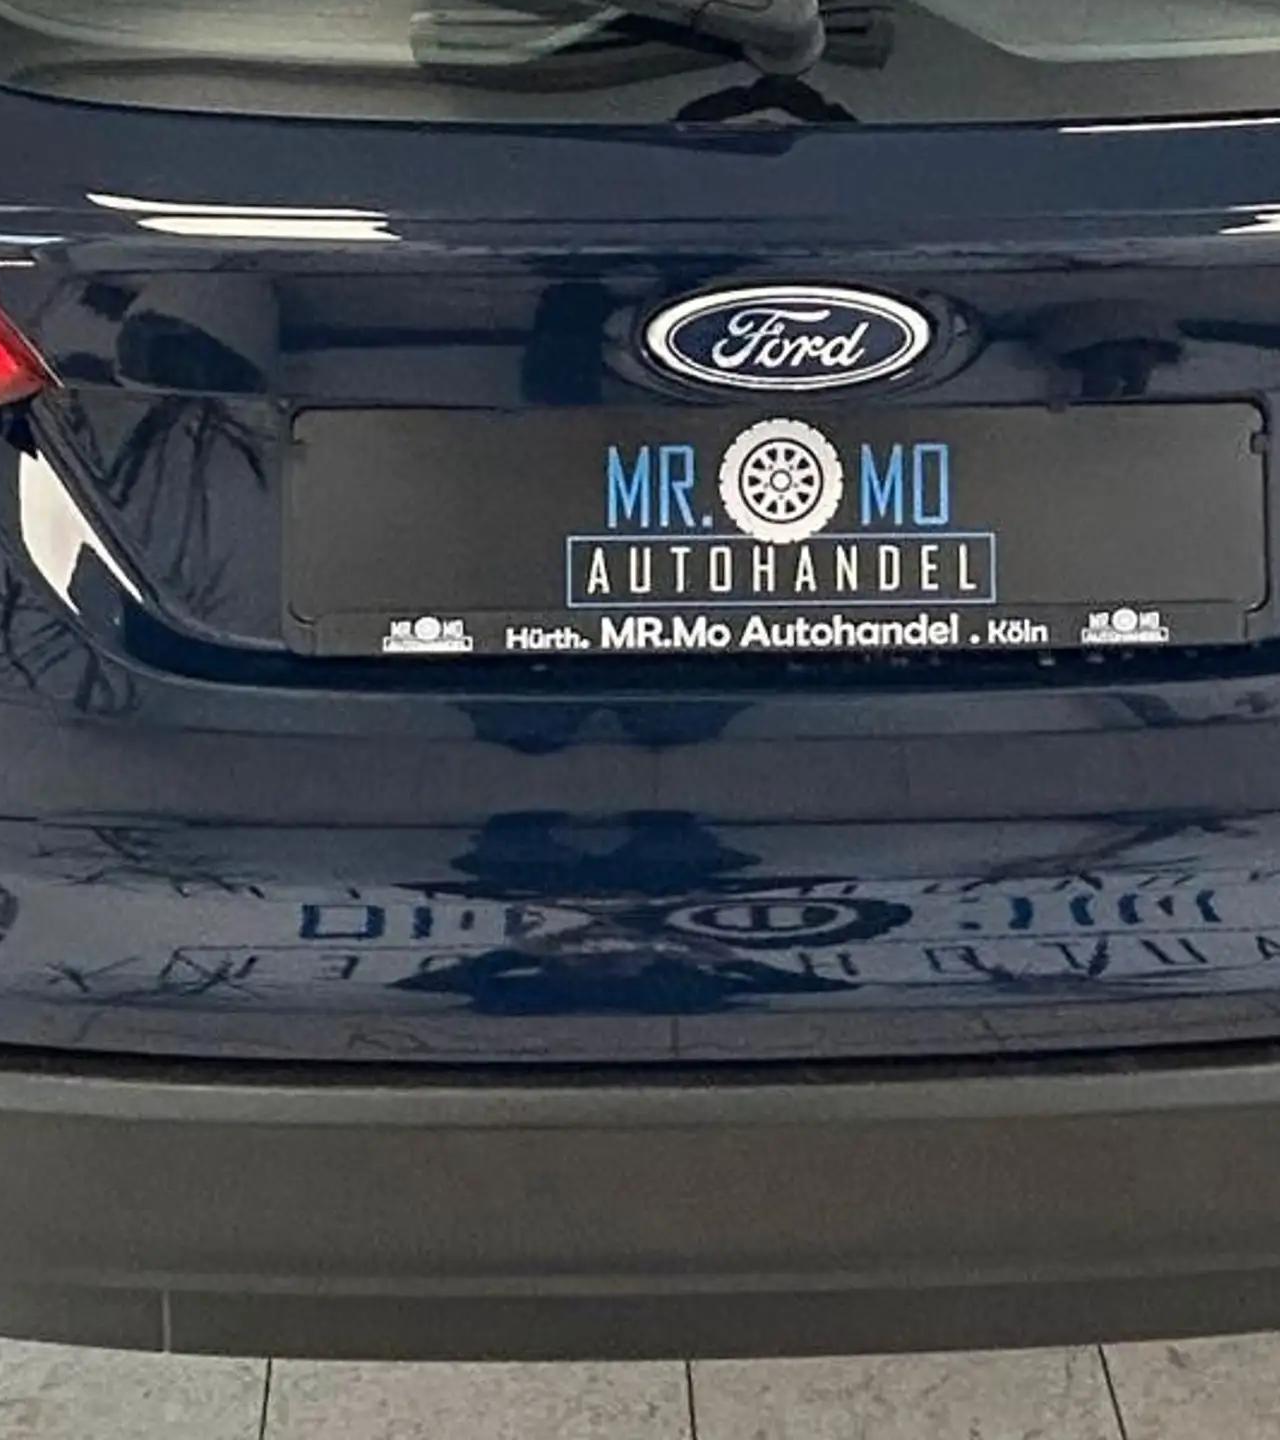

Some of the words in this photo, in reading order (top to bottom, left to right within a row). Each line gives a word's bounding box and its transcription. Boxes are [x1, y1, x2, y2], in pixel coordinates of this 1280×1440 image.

[711, 308, 870, 368] Ford
[606, 444, 714, 528] MR.
[860, 444, 950, 526] MO
[587, 544, 978, 594] AUTOHANDEL
[505, 626, 591, 650] Hürth.
[601, 615, 731, 649] MR.Mo
[740, 613, 959, 648] Autohandel
[987, 618, 1049, 644] Köln
